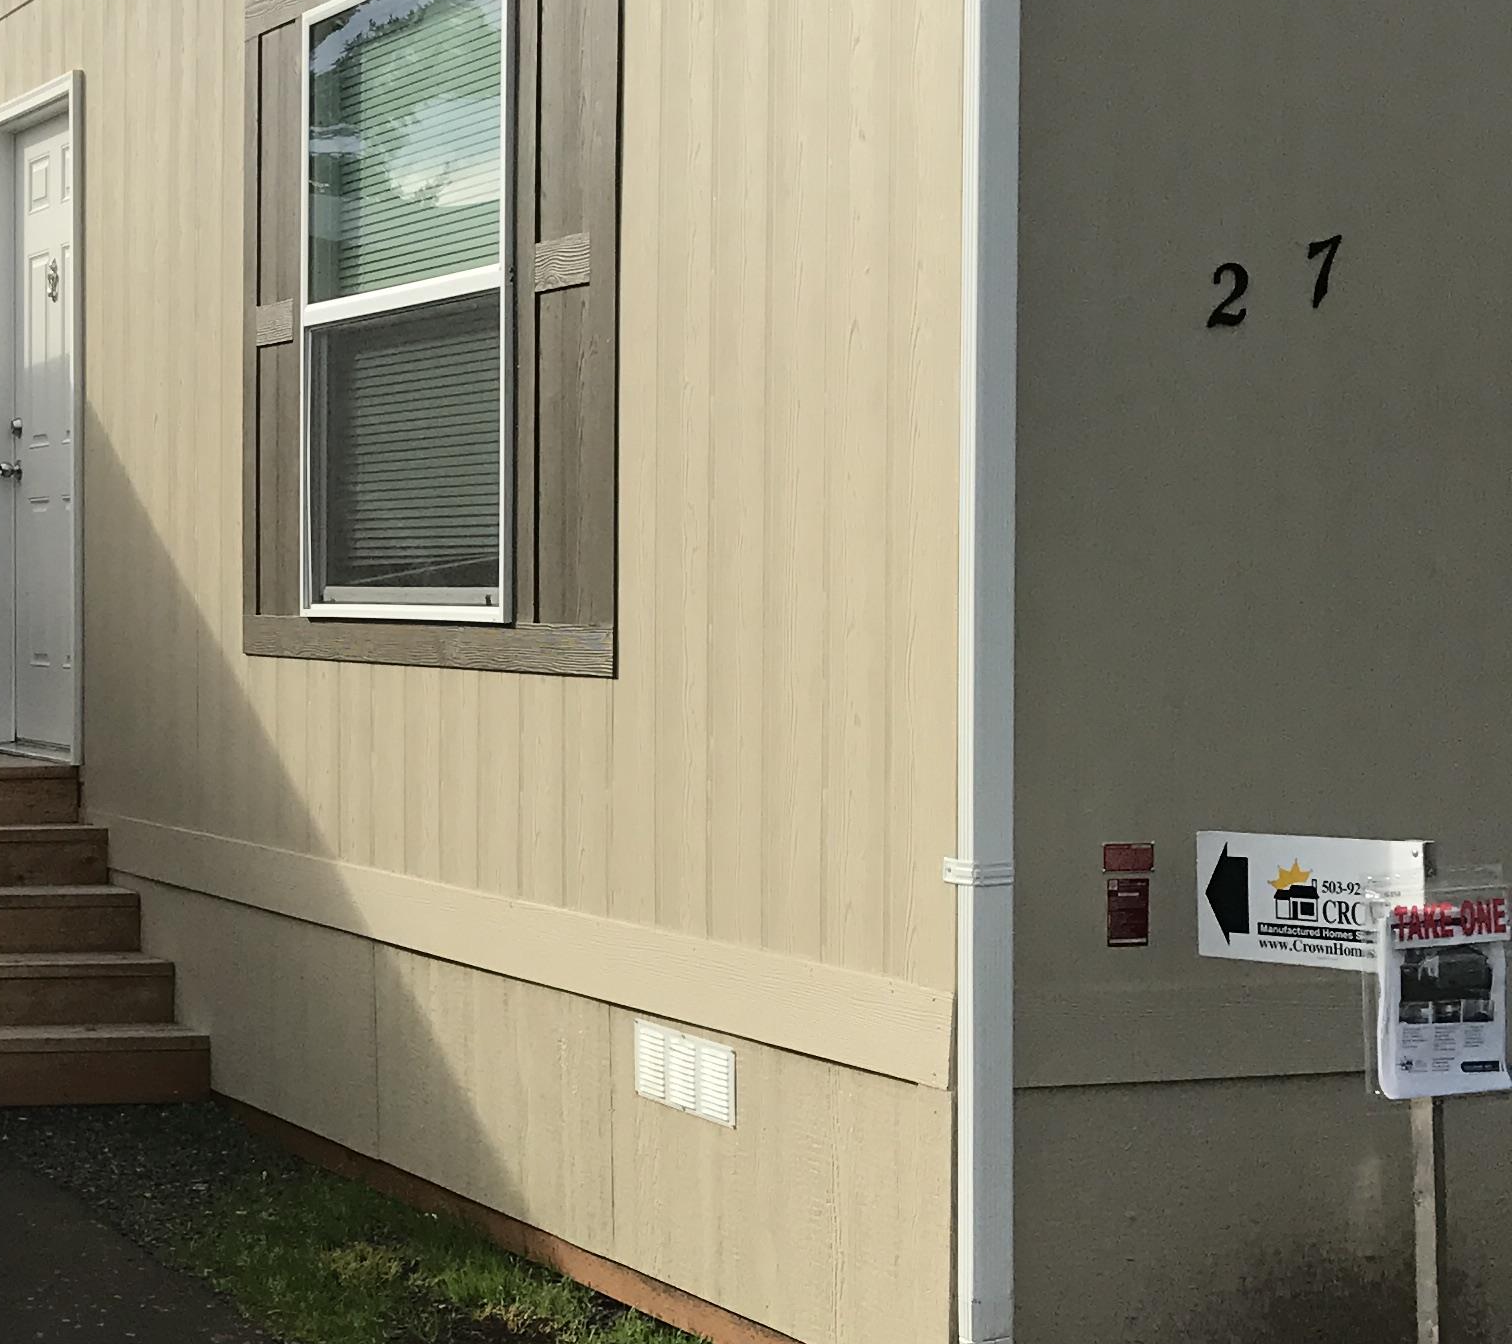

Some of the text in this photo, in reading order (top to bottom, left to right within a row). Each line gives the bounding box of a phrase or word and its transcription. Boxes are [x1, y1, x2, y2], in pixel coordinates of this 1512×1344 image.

[1206, 234, 1343, 329] 27
[1321, 880, 1362, 896] 503-92
[1322, 899, 1368, 927] CRO
[1392, 898, 1507, 942] TAKE ONE
[1260, 924, 1321, 937] Manufactured
[1323, 928, 1354, 940] Homes
[1258, 939, 1368, 958] www.CrownHom
